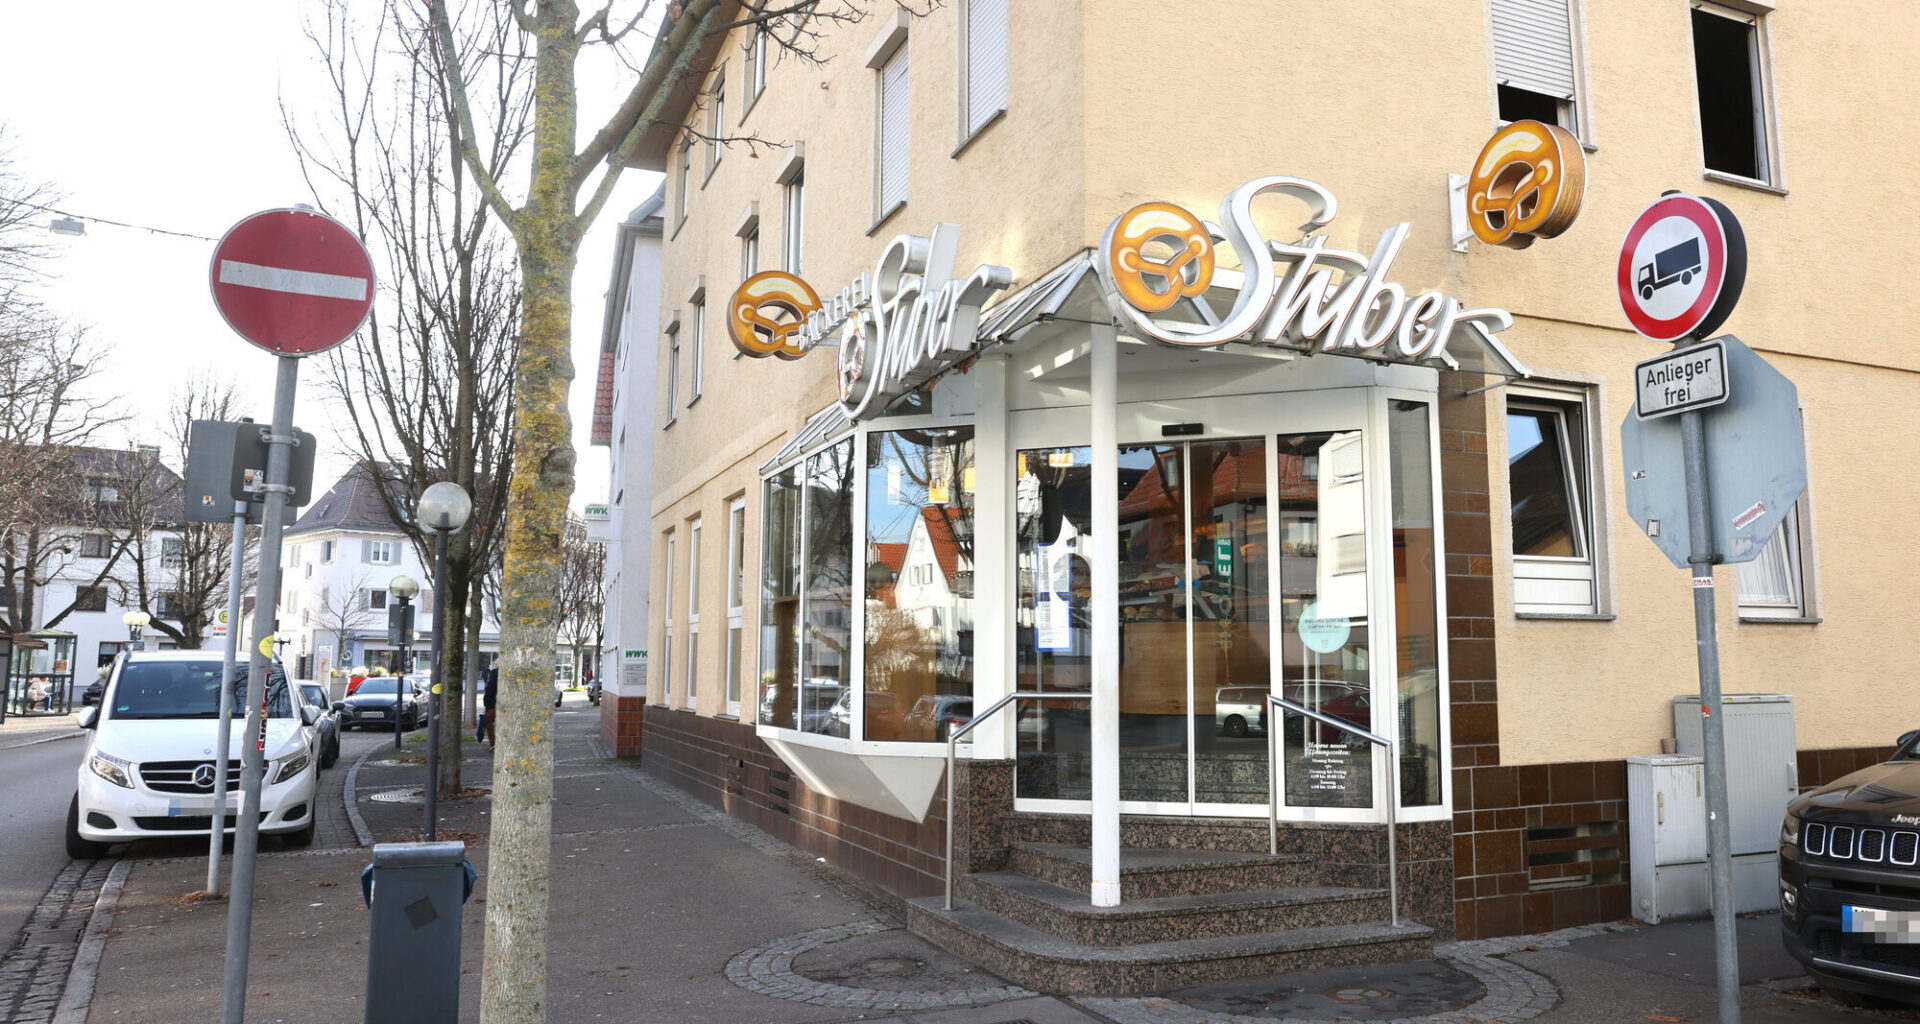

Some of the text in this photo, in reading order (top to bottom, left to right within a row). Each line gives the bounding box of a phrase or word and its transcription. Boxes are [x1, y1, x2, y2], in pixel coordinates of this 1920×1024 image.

[1105, 175, 1513, 359] Stuber
[1646, 358, 1712, 388] Anlieger
[1664, 382, 1691, 406] frei
[585, 507, 608, 515] WWK
[1891, 814, 1920, 826] Jeep
